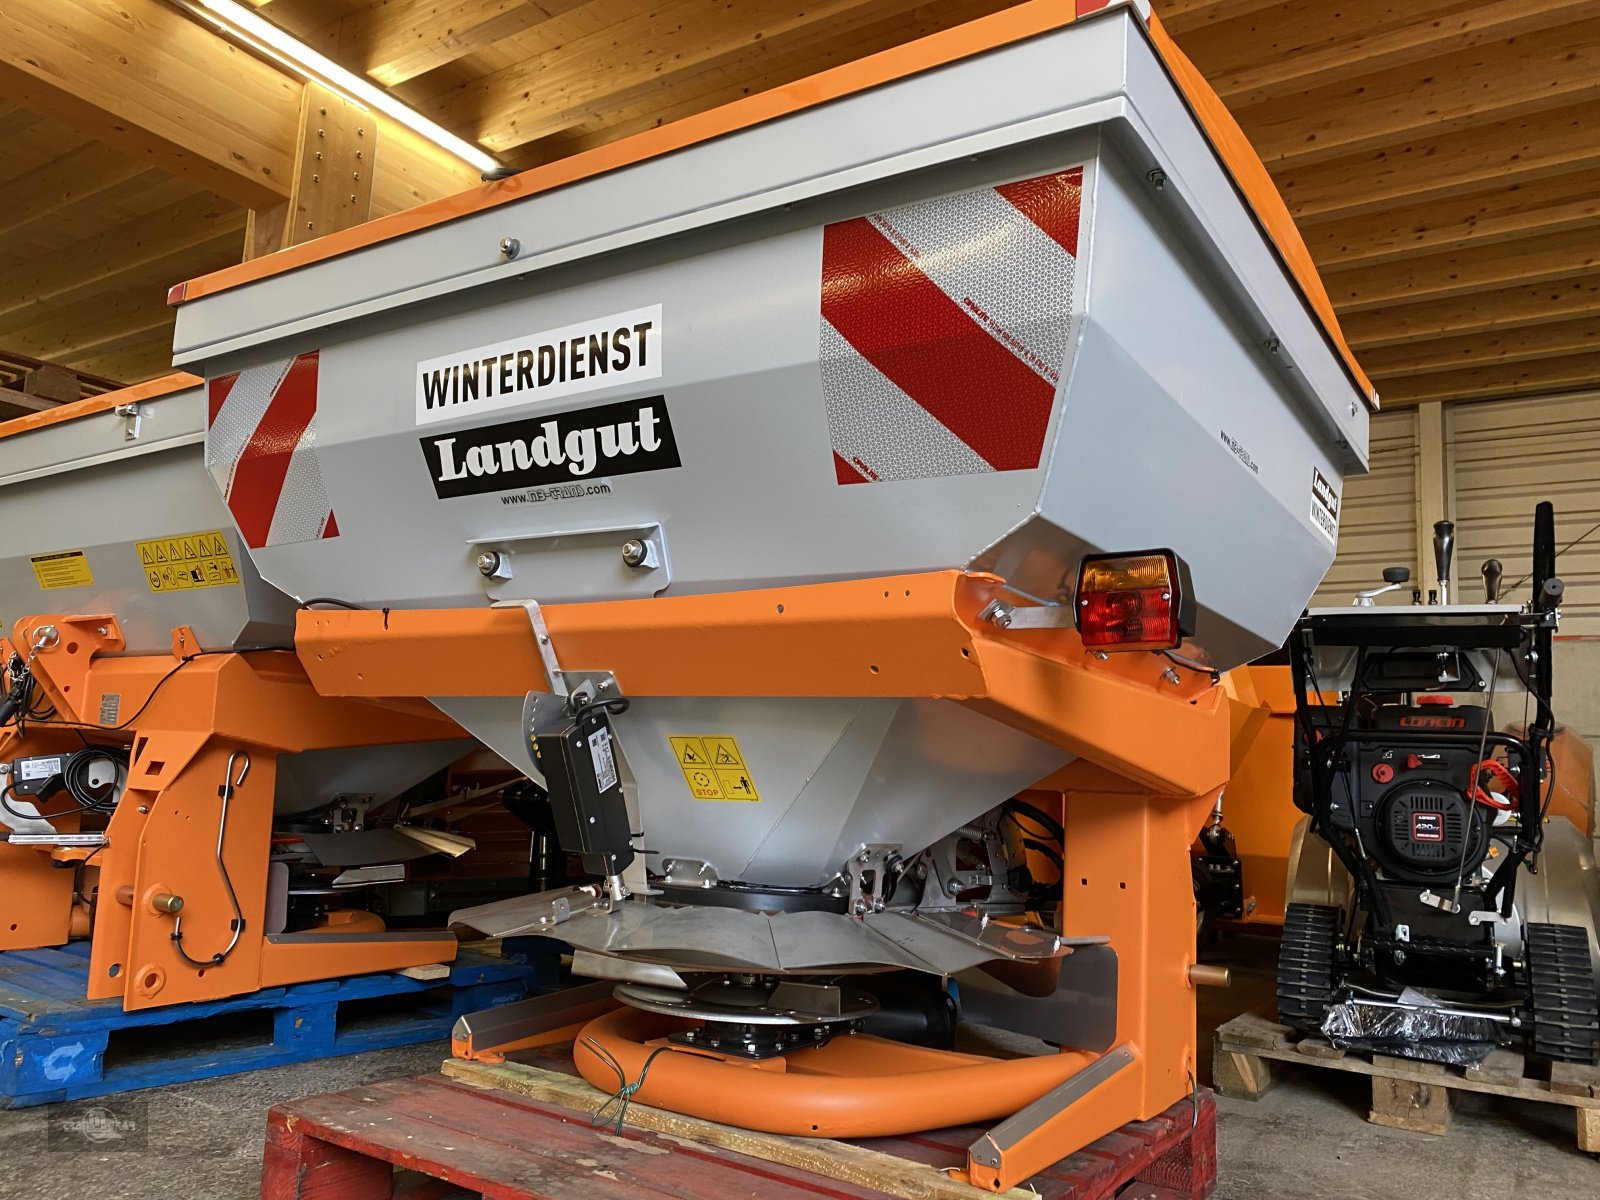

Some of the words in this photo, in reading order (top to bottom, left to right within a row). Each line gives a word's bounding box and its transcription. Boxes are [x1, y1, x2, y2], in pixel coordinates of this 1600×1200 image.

[422, 321, 653, 410] WINTERDIENST
[434, 406, 662, 482] Landgut
[696, 788, 719, 797] STOP
